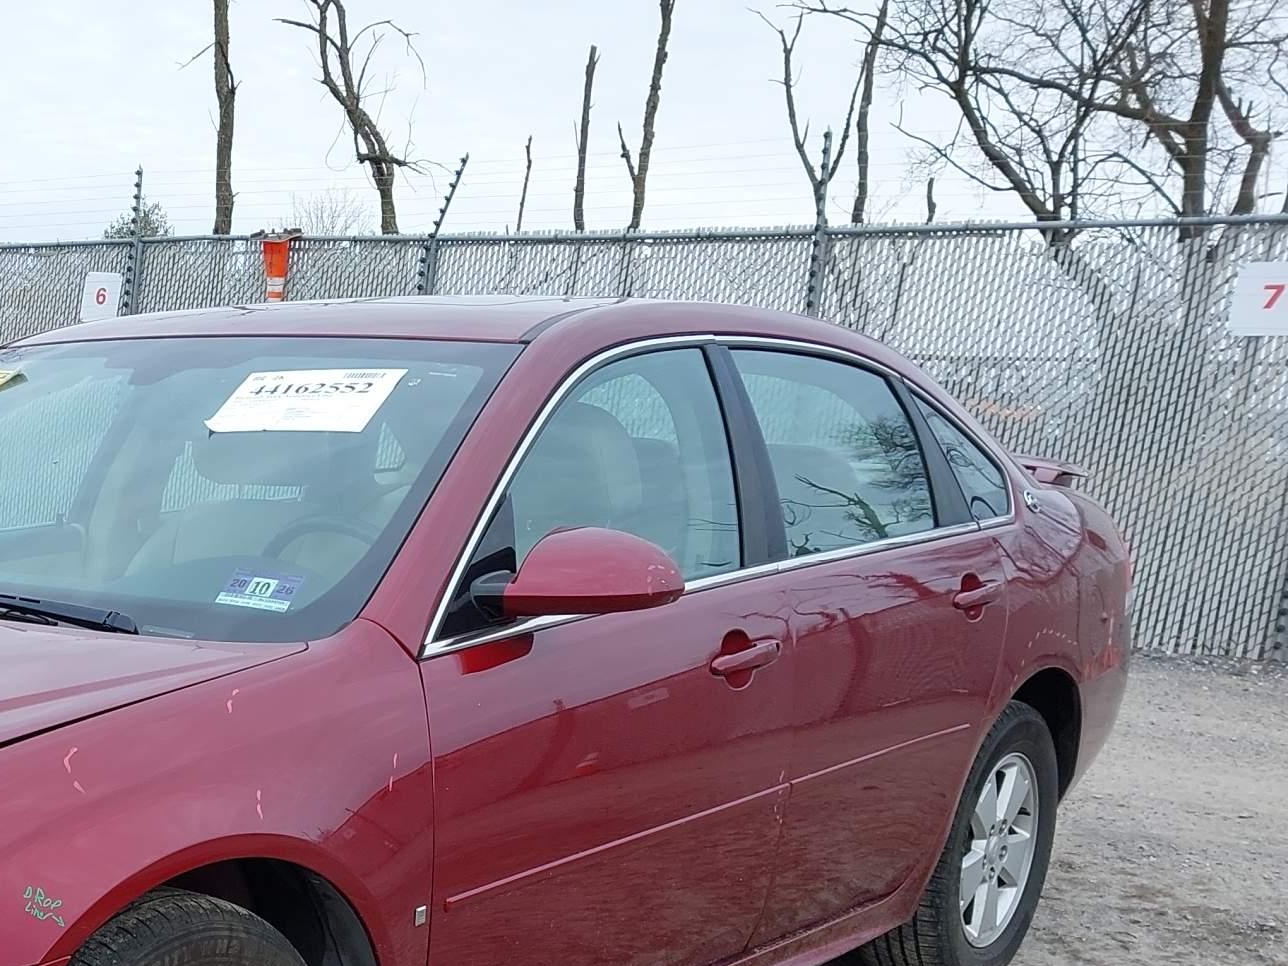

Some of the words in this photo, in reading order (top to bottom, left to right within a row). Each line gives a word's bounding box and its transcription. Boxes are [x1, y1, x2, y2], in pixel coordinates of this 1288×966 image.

[95, 287, 107, 305] 6
[1263, 284, 1286, 310] 7
[250, 382, 374, 396] 44162552
[230, 578, 248, 589] 20
[249, 580, 271, 595] 10
